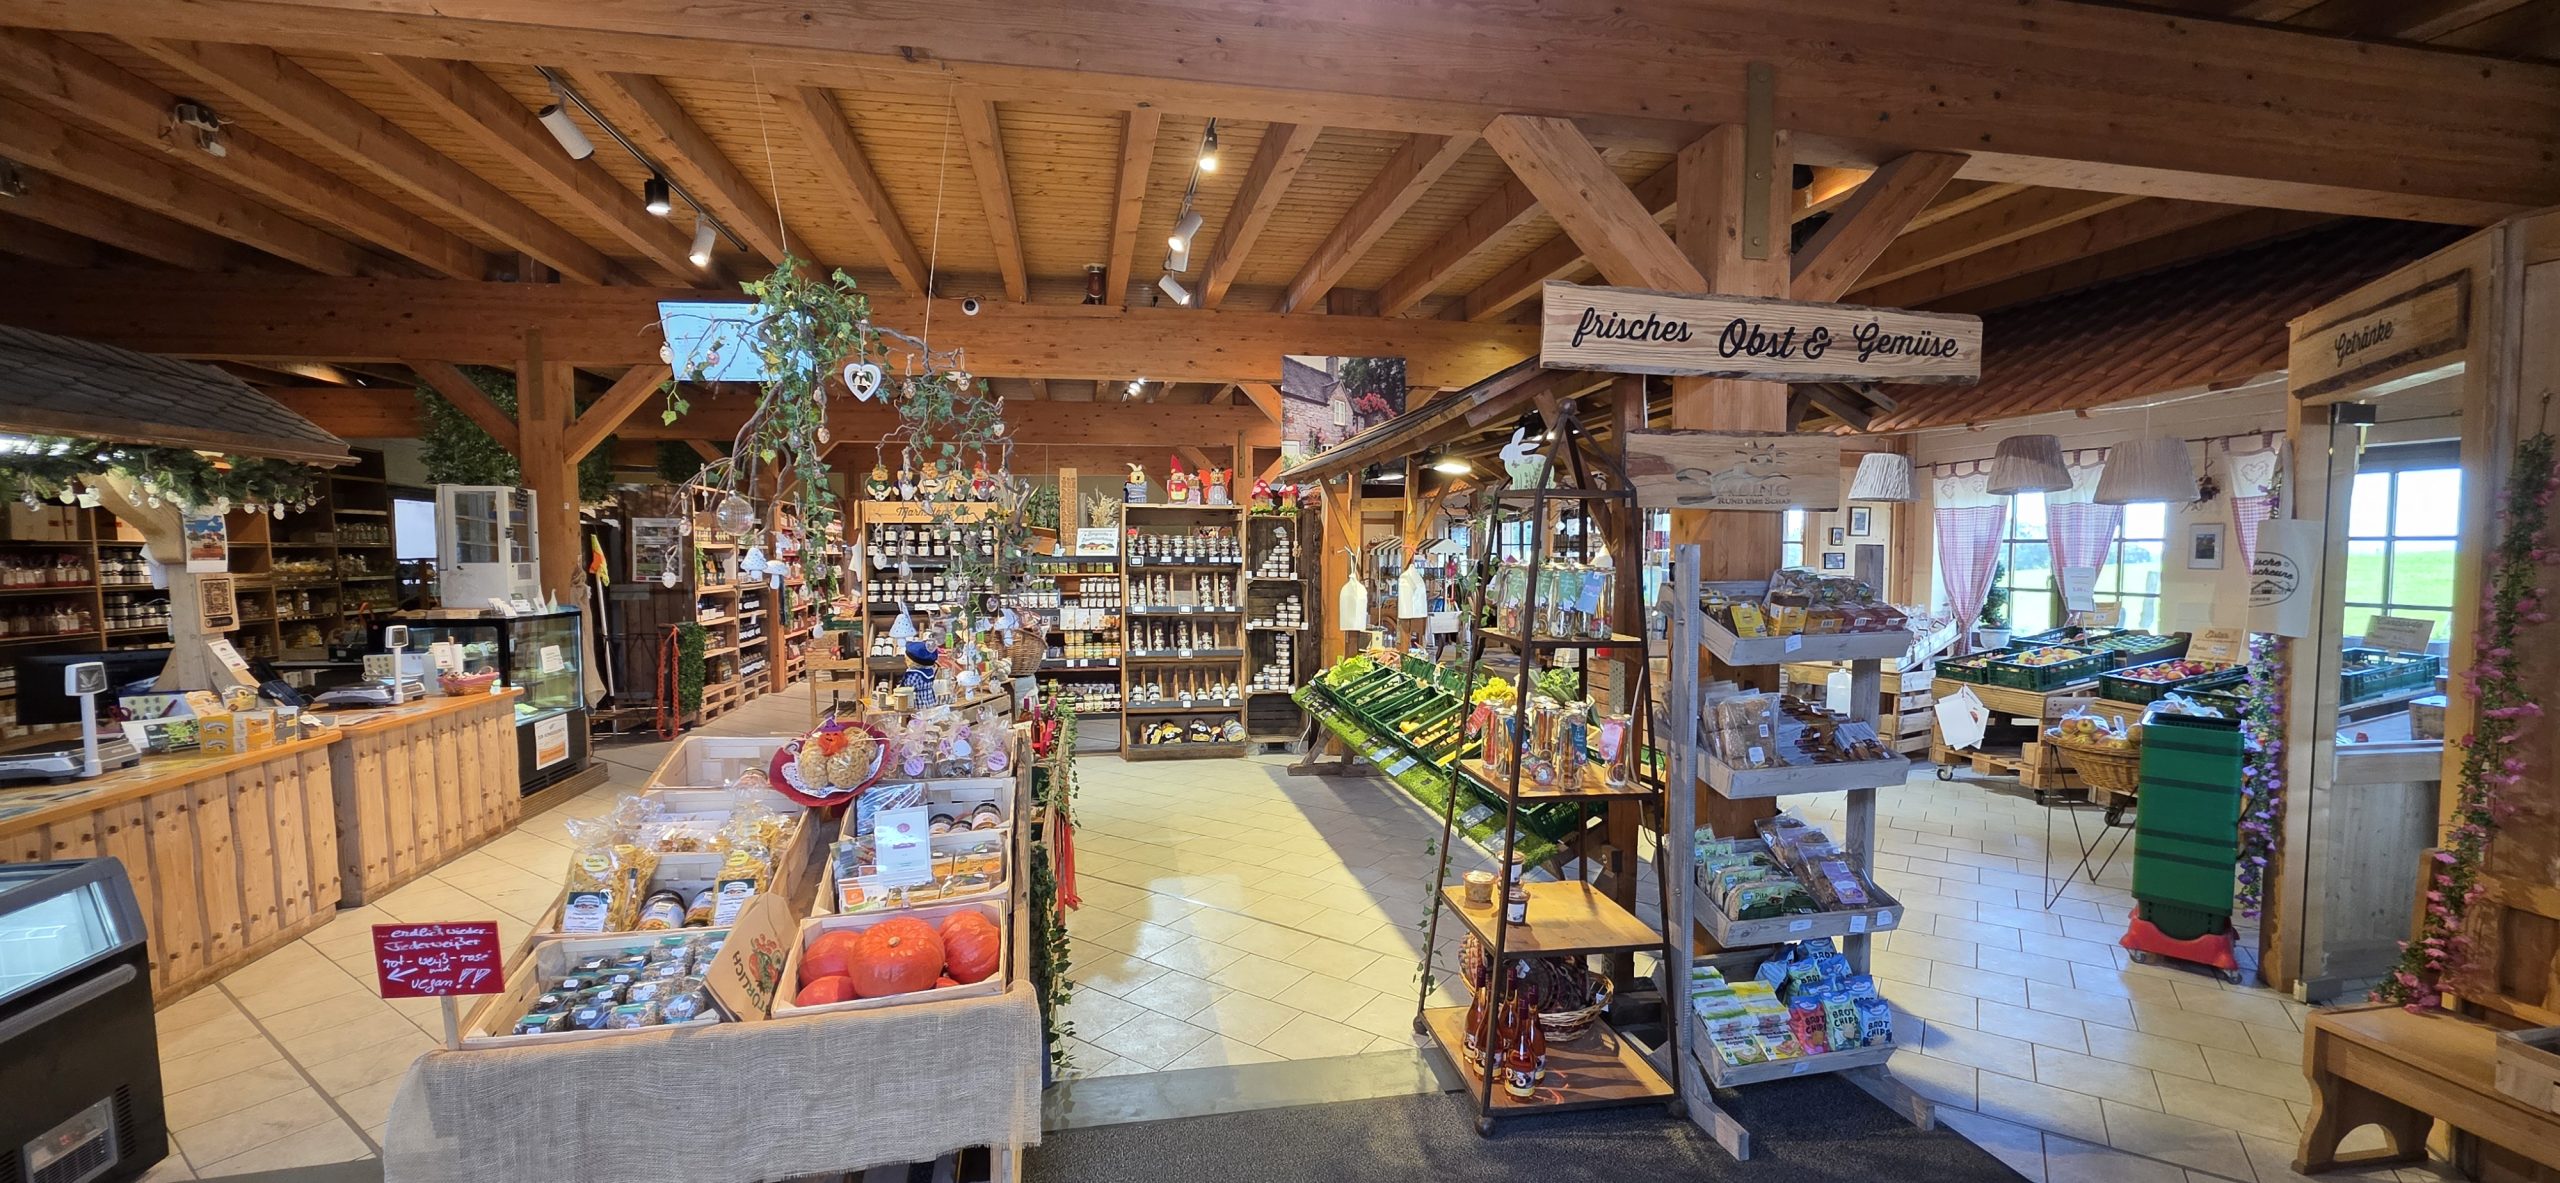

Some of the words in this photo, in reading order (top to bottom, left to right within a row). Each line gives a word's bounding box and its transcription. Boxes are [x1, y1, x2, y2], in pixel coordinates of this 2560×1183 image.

[1571, 306, 1693, 348] frisches
[1718, 317, 1796, 358] Obst
[1803, 326, 1833, 360] &
[1852, 322, 1959, 363] Gemüse
[2334, 318, 2395, 368] Getränke
[1833, 1008, 1854, 1019] BROT
[1805, 1015, 1825, 1026] BROT
[1834, 1017, 1859, 1027] CHIPS
[1868, 1020, 1889, 1030] BROT
[1866, 1029, 1891, 1038] CHIPS
